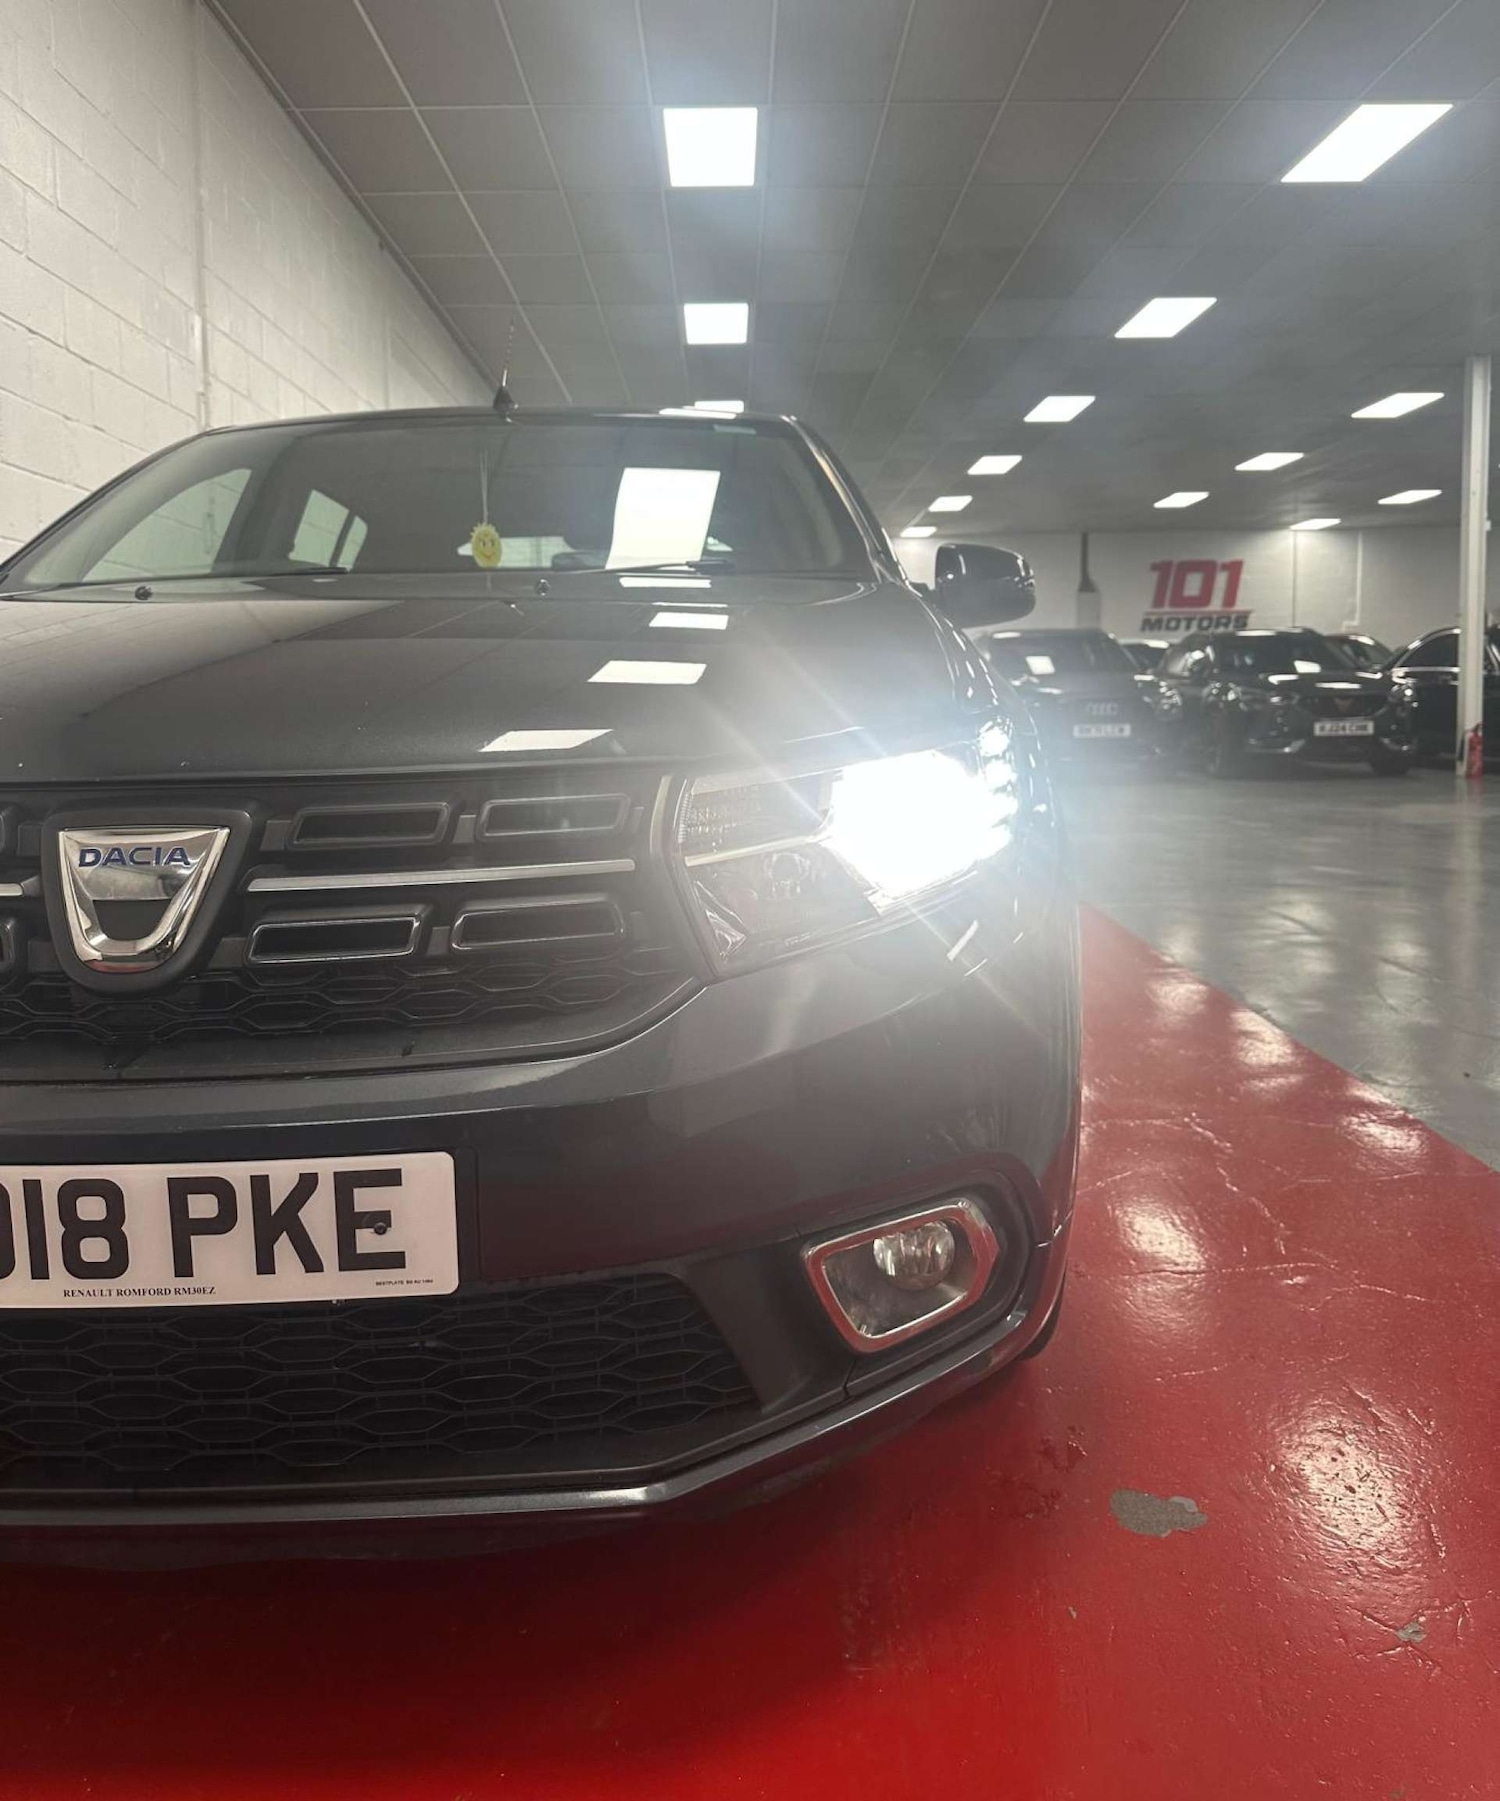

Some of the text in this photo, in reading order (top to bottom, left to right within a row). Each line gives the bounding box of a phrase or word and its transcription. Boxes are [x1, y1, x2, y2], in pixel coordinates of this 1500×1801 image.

[1150, 559, 1244, 609] 101
[1140, 614, 1249, 632] MOTORS
[79, 846, 191, 867] DACIA
[0, 1168, 406, 1280] 18 PKE
[63, 1286, 216, 1298] RENAULT ROMFORD RM30EZ
